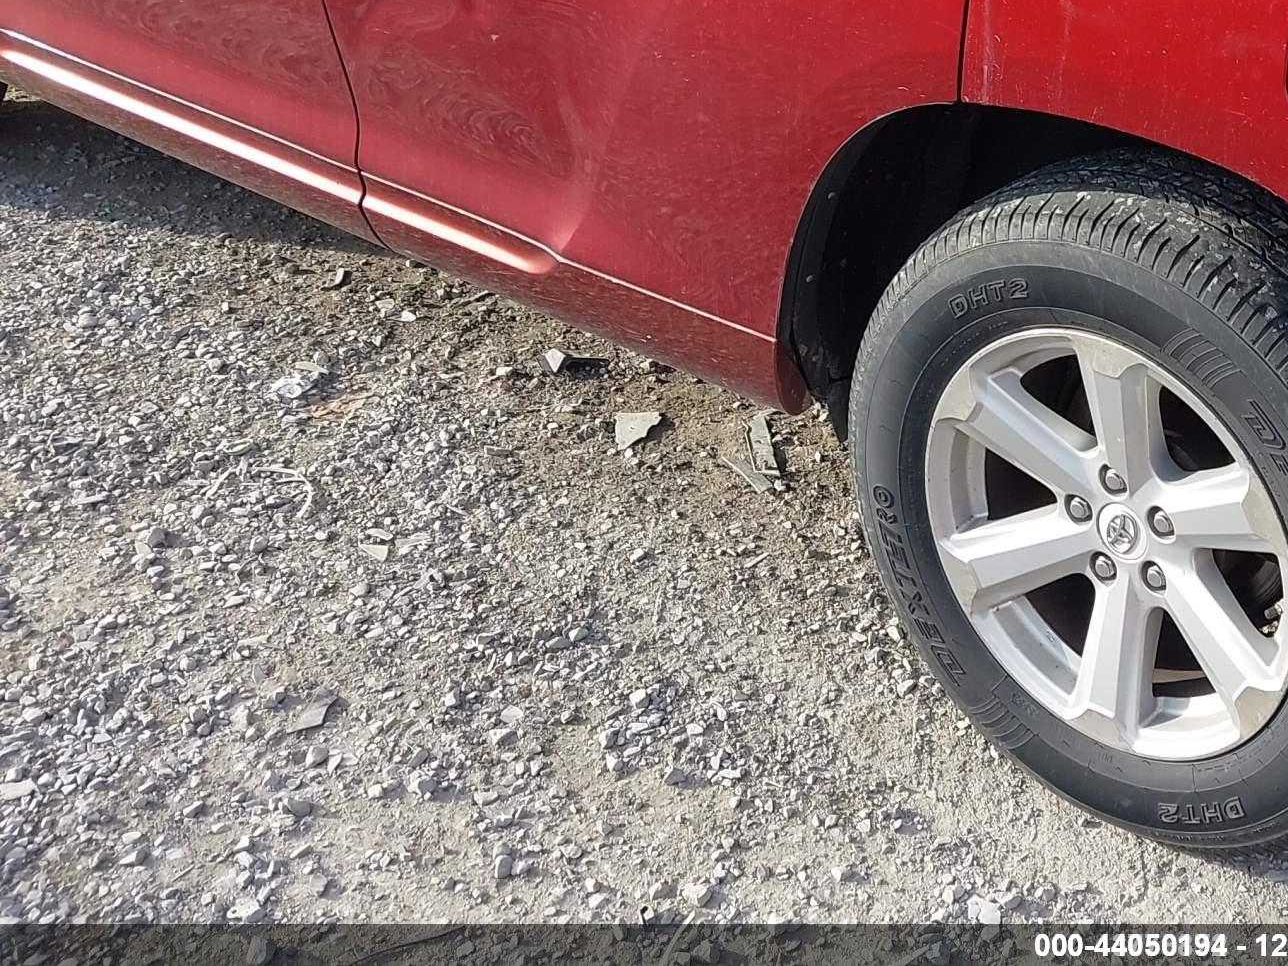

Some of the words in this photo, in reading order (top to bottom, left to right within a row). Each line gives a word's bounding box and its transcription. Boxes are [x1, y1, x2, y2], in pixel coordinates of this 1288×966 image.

[948, 277, 1029, 319] DHT2
[872, 485, 967, 688] DEXTERO
[1157, 795, 1247, 825] DHT2
